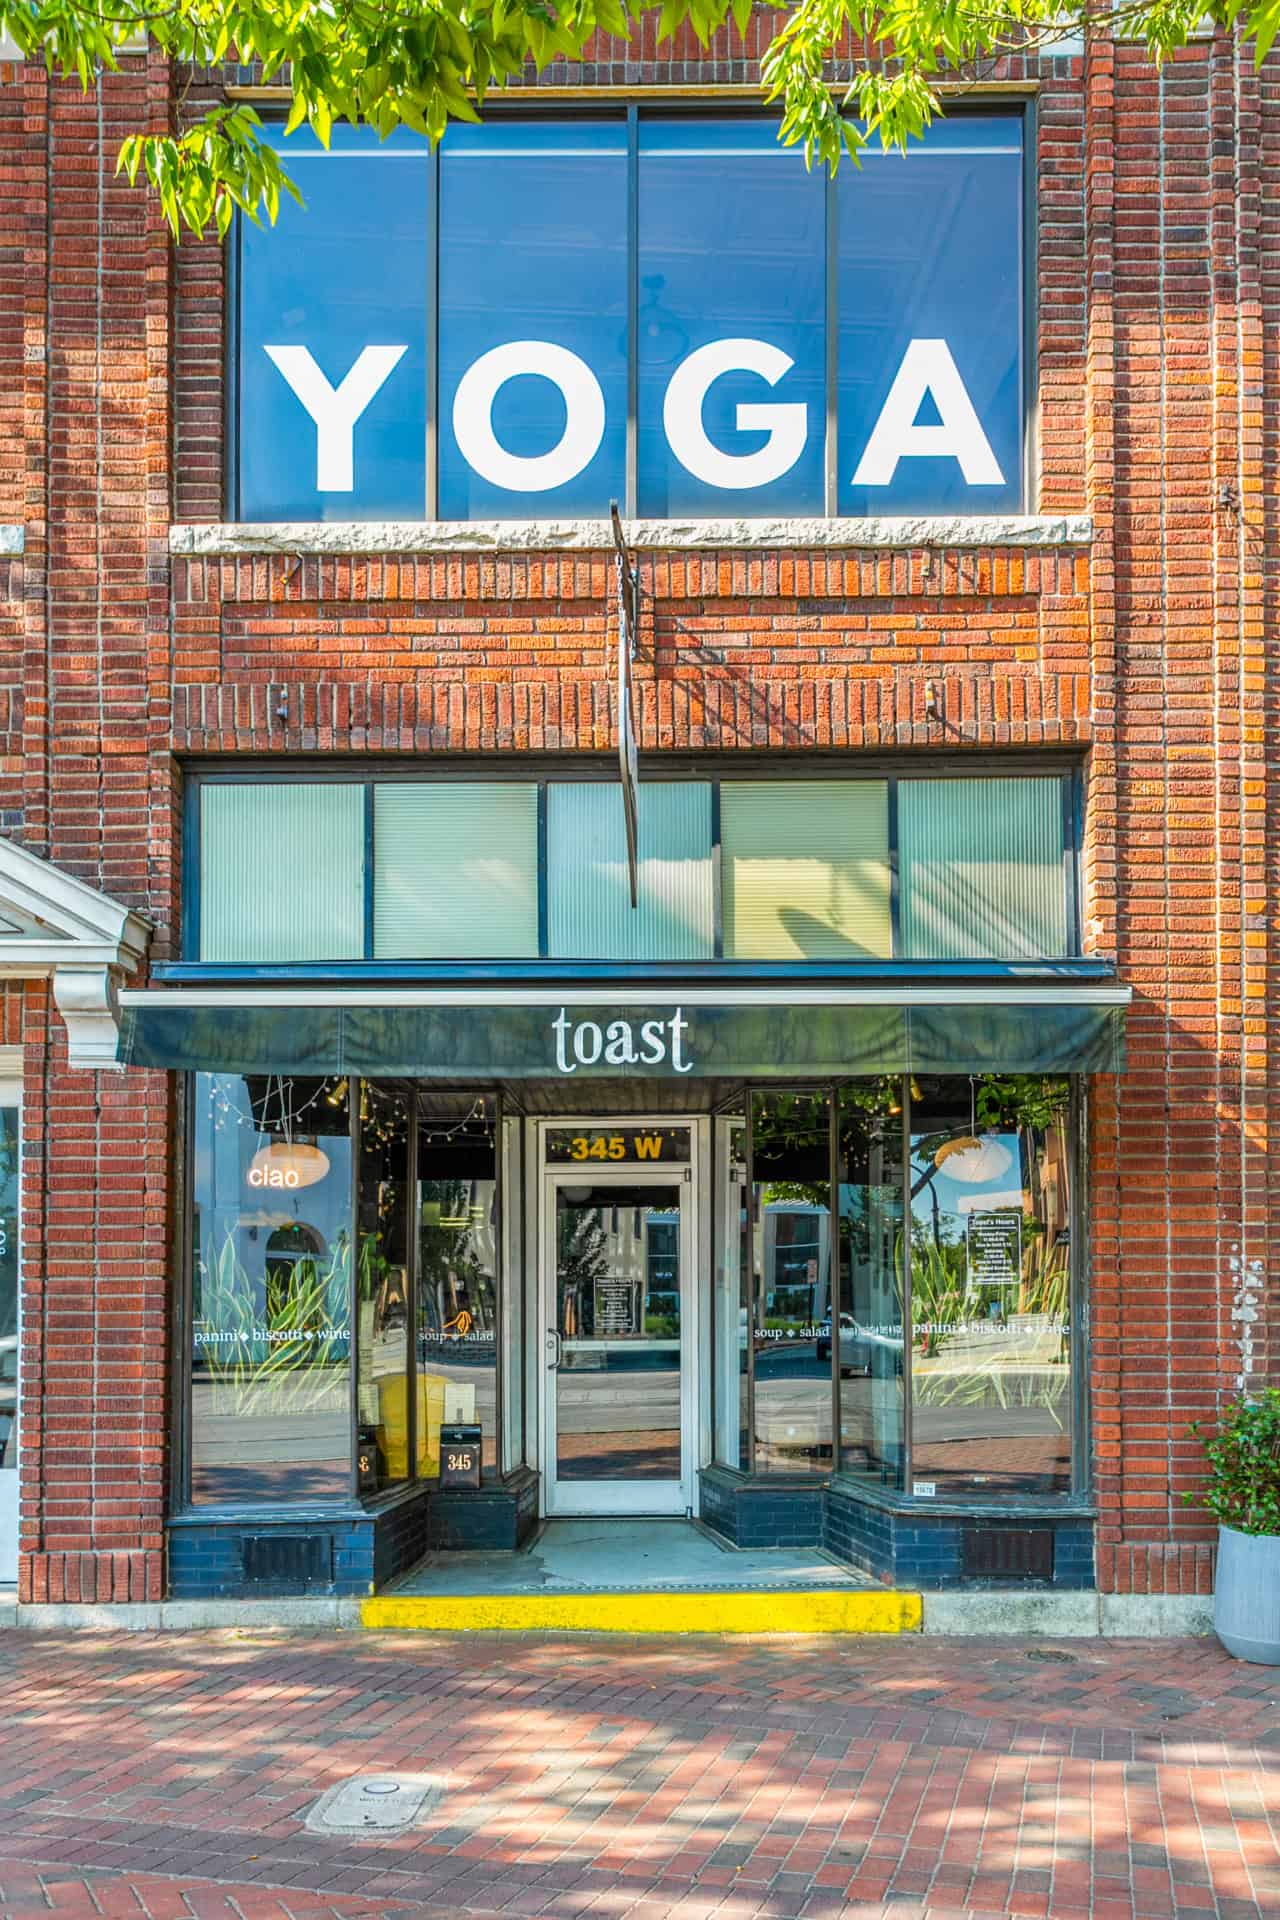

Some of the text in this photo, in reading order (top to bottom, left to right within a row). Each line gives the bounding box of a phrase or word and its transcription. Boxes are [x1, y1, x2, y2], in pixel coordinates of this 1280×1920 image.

[264, 338, 1006, 493] YOGA
[551, 1007, 694, 1073] toast
[571, 1136, 663, 1160] 345 W
[248, 1163, 299, 1188] ciao
[193, 1327, 351, 1346] panini biscotti wine
[418, 1329, 494, 1345] soup salad
[753, 1327, 783, 1341] soup
[799, 1325, 830, 1338] salad
[911, 1321, 956, 1338] panini
[447, 1454, 472, 1471] 345
